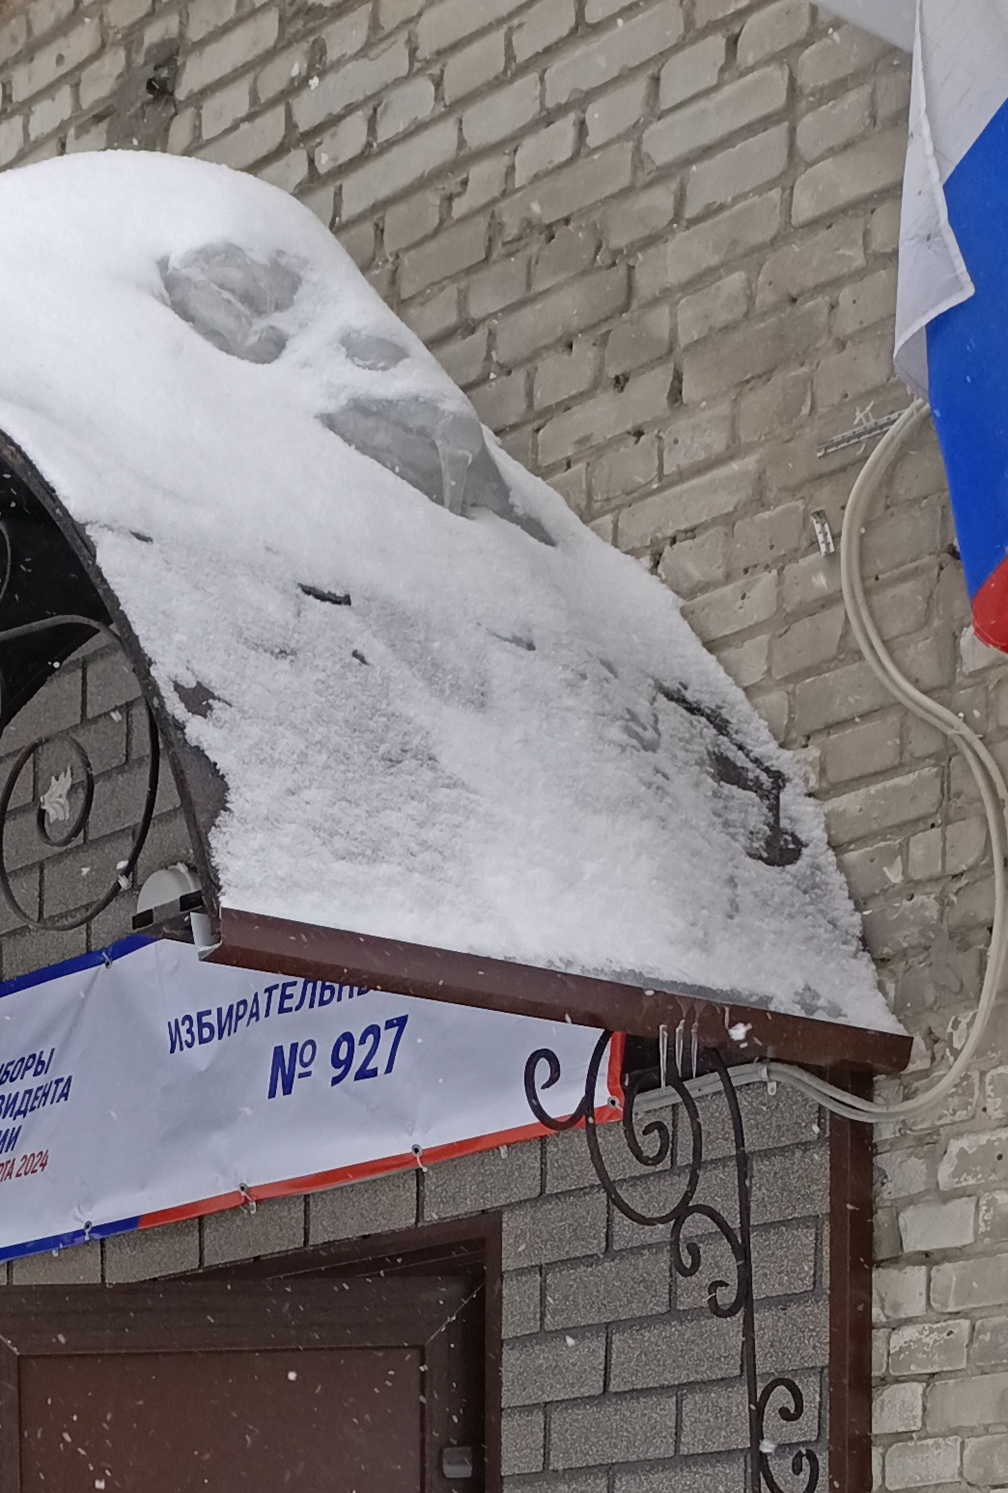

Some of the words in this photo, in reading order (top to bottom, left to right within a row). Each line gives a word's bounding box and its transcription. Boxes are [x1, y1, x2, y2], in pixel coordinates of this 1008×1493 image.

[267, 1038, 317, 1099] №
[330, 1014, 409, 1087] 927
[14, 1148, 50, 1179] 2024
